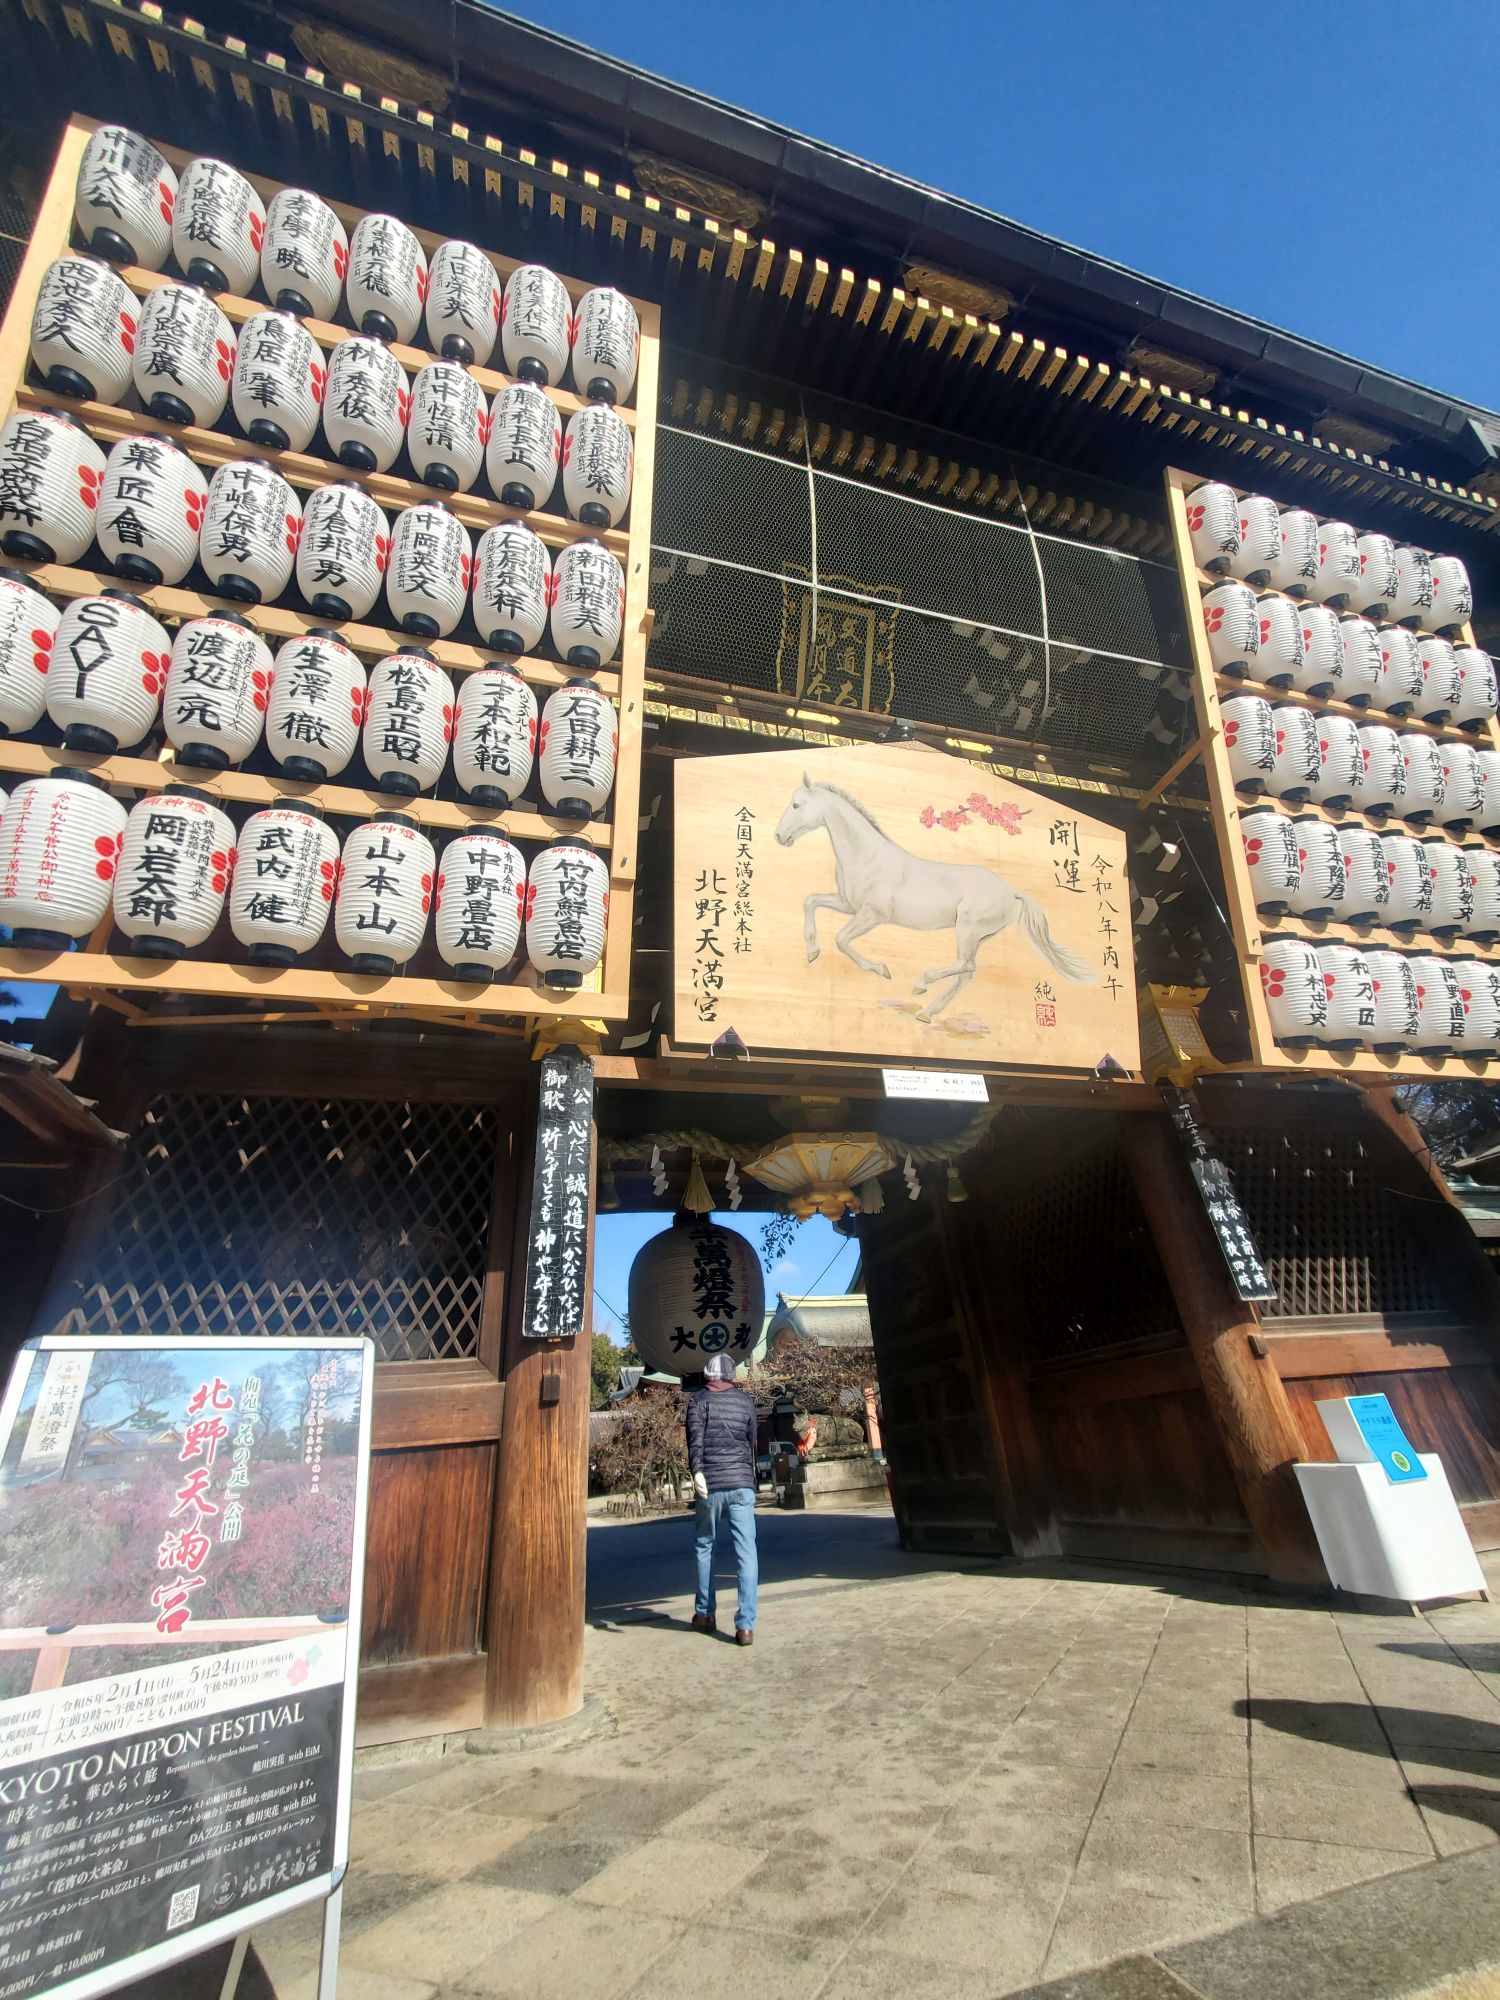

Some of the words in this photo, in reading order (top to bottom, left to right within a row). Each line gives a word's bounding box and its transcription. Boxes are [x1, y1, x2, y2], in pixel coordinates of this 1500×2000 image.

[418, 390, 426, 409] 宮司
[425, 367, 463, 451] 田中恒清
[215, 468, 267, 563] 中嶋保男
[312, 491, 360, 587] 小倉邦男
[403, 512, 444, 600] 中岡英文
[490, 531, 530, 621] 石原定祥
[571, 549, 610, 637] 新田雅美
[69, 602, 120, 700] SAY
[279, 645, 333, 750] 生澤徹
[381, 664, 431, 764] 松島正昭
[472, 679, 514, 776] 吉本和範
[142, 797, 208, 815] 御神燈
[255, 810, 315, 828] 御神燈
[362, 823, 416, 840] 御神燈
[127, 813, 189, 927] 岡岩太郎
[243, 827, 295, 923] 武内健
[357, 836, 406, 934] 山本山
[454, 848, 502, 950] 中野畳店
[501, 851, 515, 896] 有限会社
[732, 806, 756, 954] 全国天満宮総本社
[1049, 820, 1088, 894] 開運
[546, 858, 594, 960] 竹内鮮魚店
[693, 869, 728, 1024] 北野天満宮
[1090, 854, 1126, 1002] 令和八年丙午
[1441, 967, 1465, 1038] 岡野直臣
[151, 1375, 235, 1635] 北野天満宮
[0, 1755, 104, 1804] KYOTO
[107, 1727, 202, 1776] NIPPON
[208, 1702, 304, 1747] FESTIVAL
[53, 1729, 77, 1745] 大人
[217, 1748, 238, 1762] garden
[288, 1750, 304, 1763] with
[304, 1744, 321, 1757] EiM
[189, 1820, 231, 1846] DAZZLE
[283, 1799, 299, 1812] with
[300, 1793, 317, 1807] EiM
